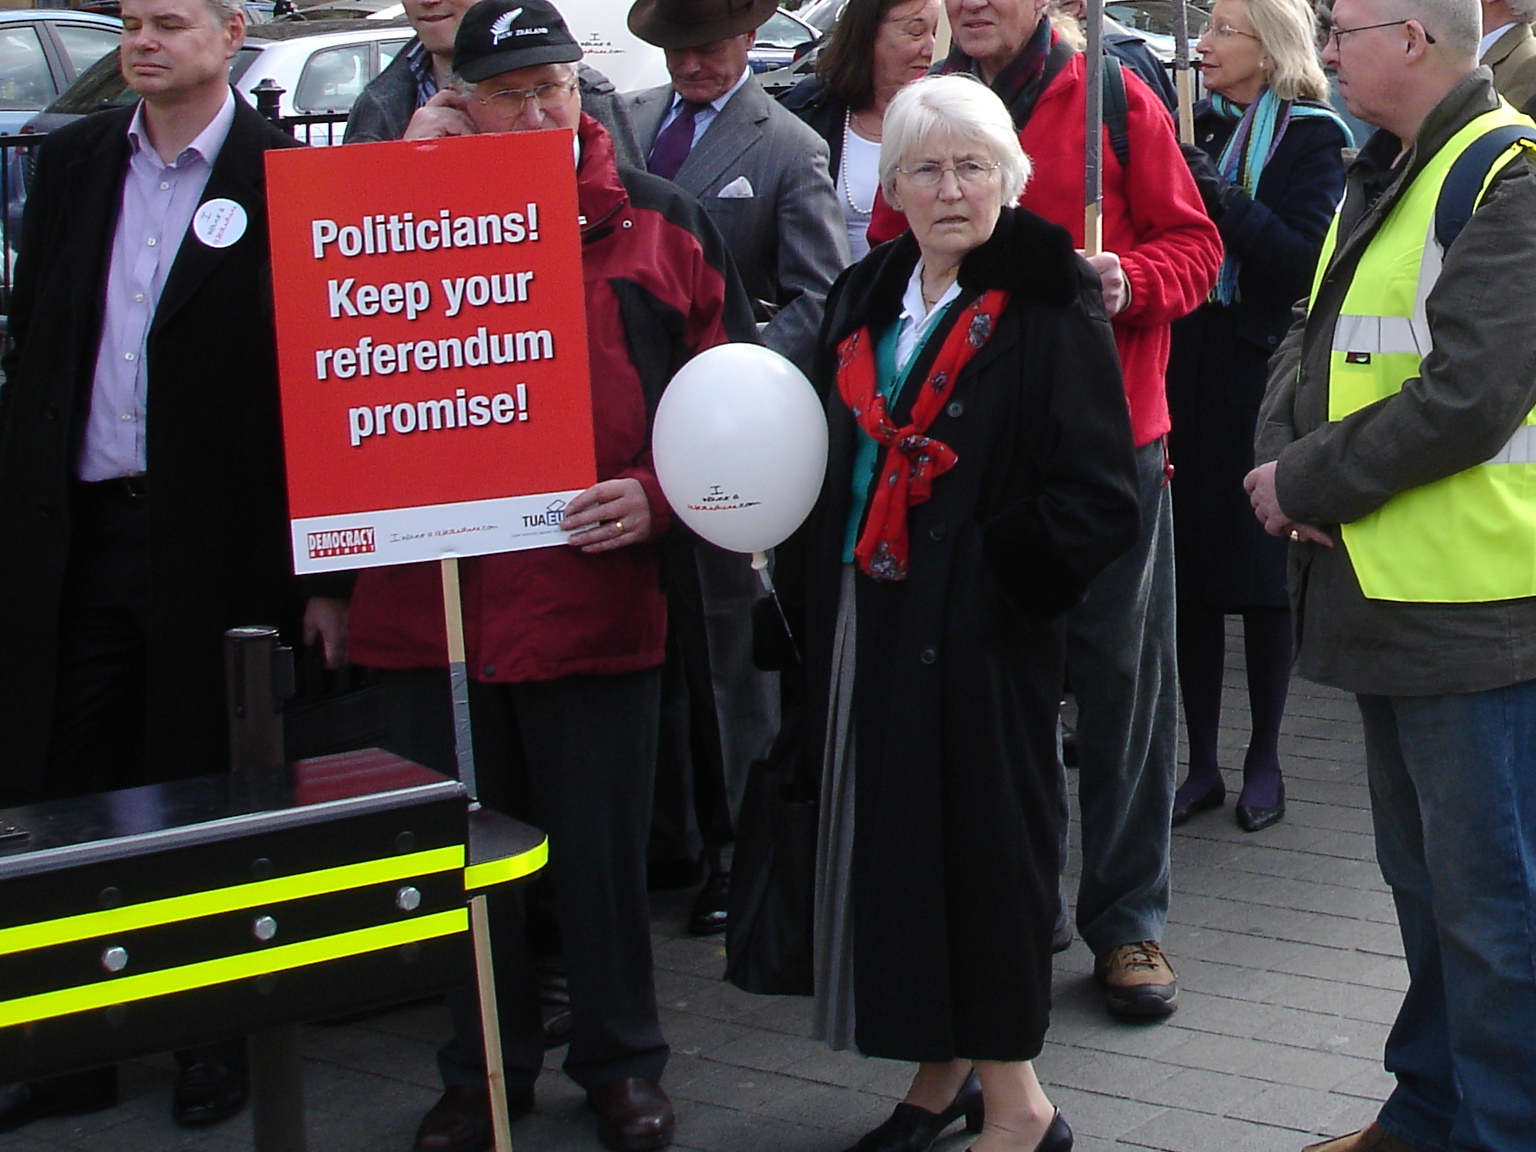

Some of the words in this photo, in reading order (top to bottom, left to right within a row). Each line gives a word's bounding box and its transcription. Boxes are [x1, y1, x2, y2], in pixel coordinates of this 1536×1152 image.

[311, 203, 541, 260] Politicians!
[328, 279, 430, 320] Keep
[444, 269, 534, 317] your
[316, 328, 554, 381] referendum
[348, 383, 529, 447] promise!
[308, 528, 375, 551] DEMOCRACY
